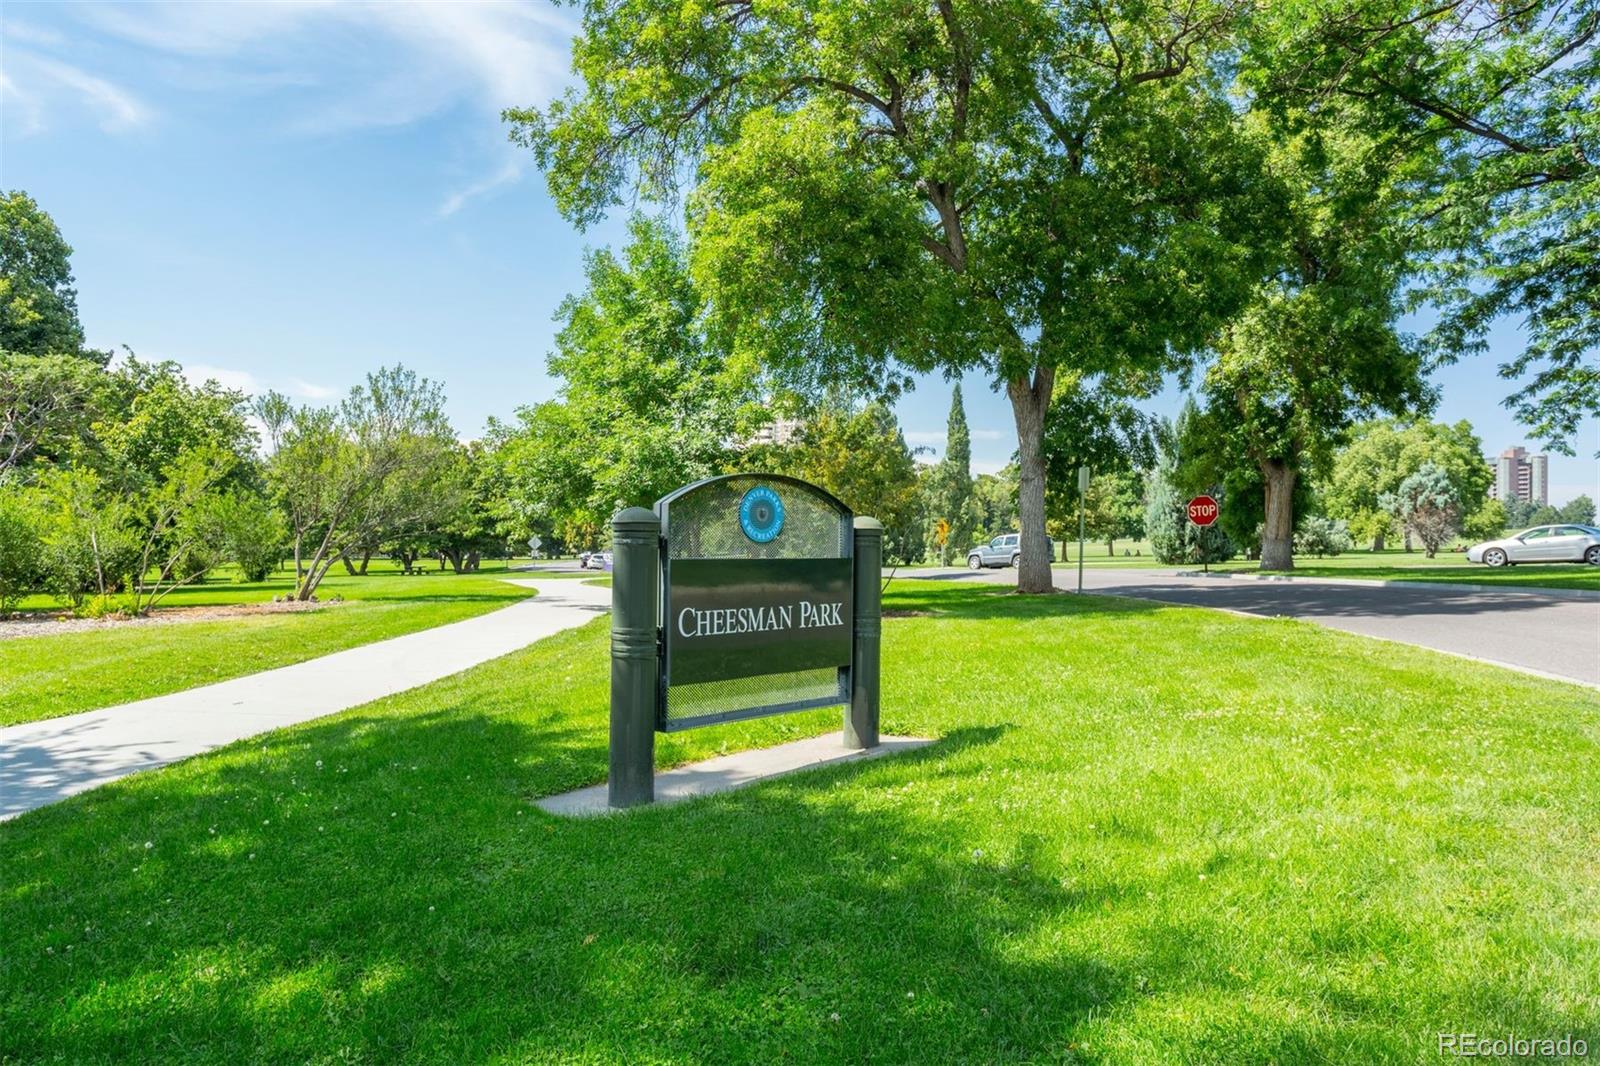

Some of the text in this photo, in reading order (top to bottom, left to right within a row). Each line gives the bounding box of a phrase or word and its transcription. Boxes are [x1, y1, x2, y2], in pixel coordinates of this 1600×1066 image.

[1190, 505, 1216, 517] STOP
[678, 601, 844, 638] CHEESMAN PARK
